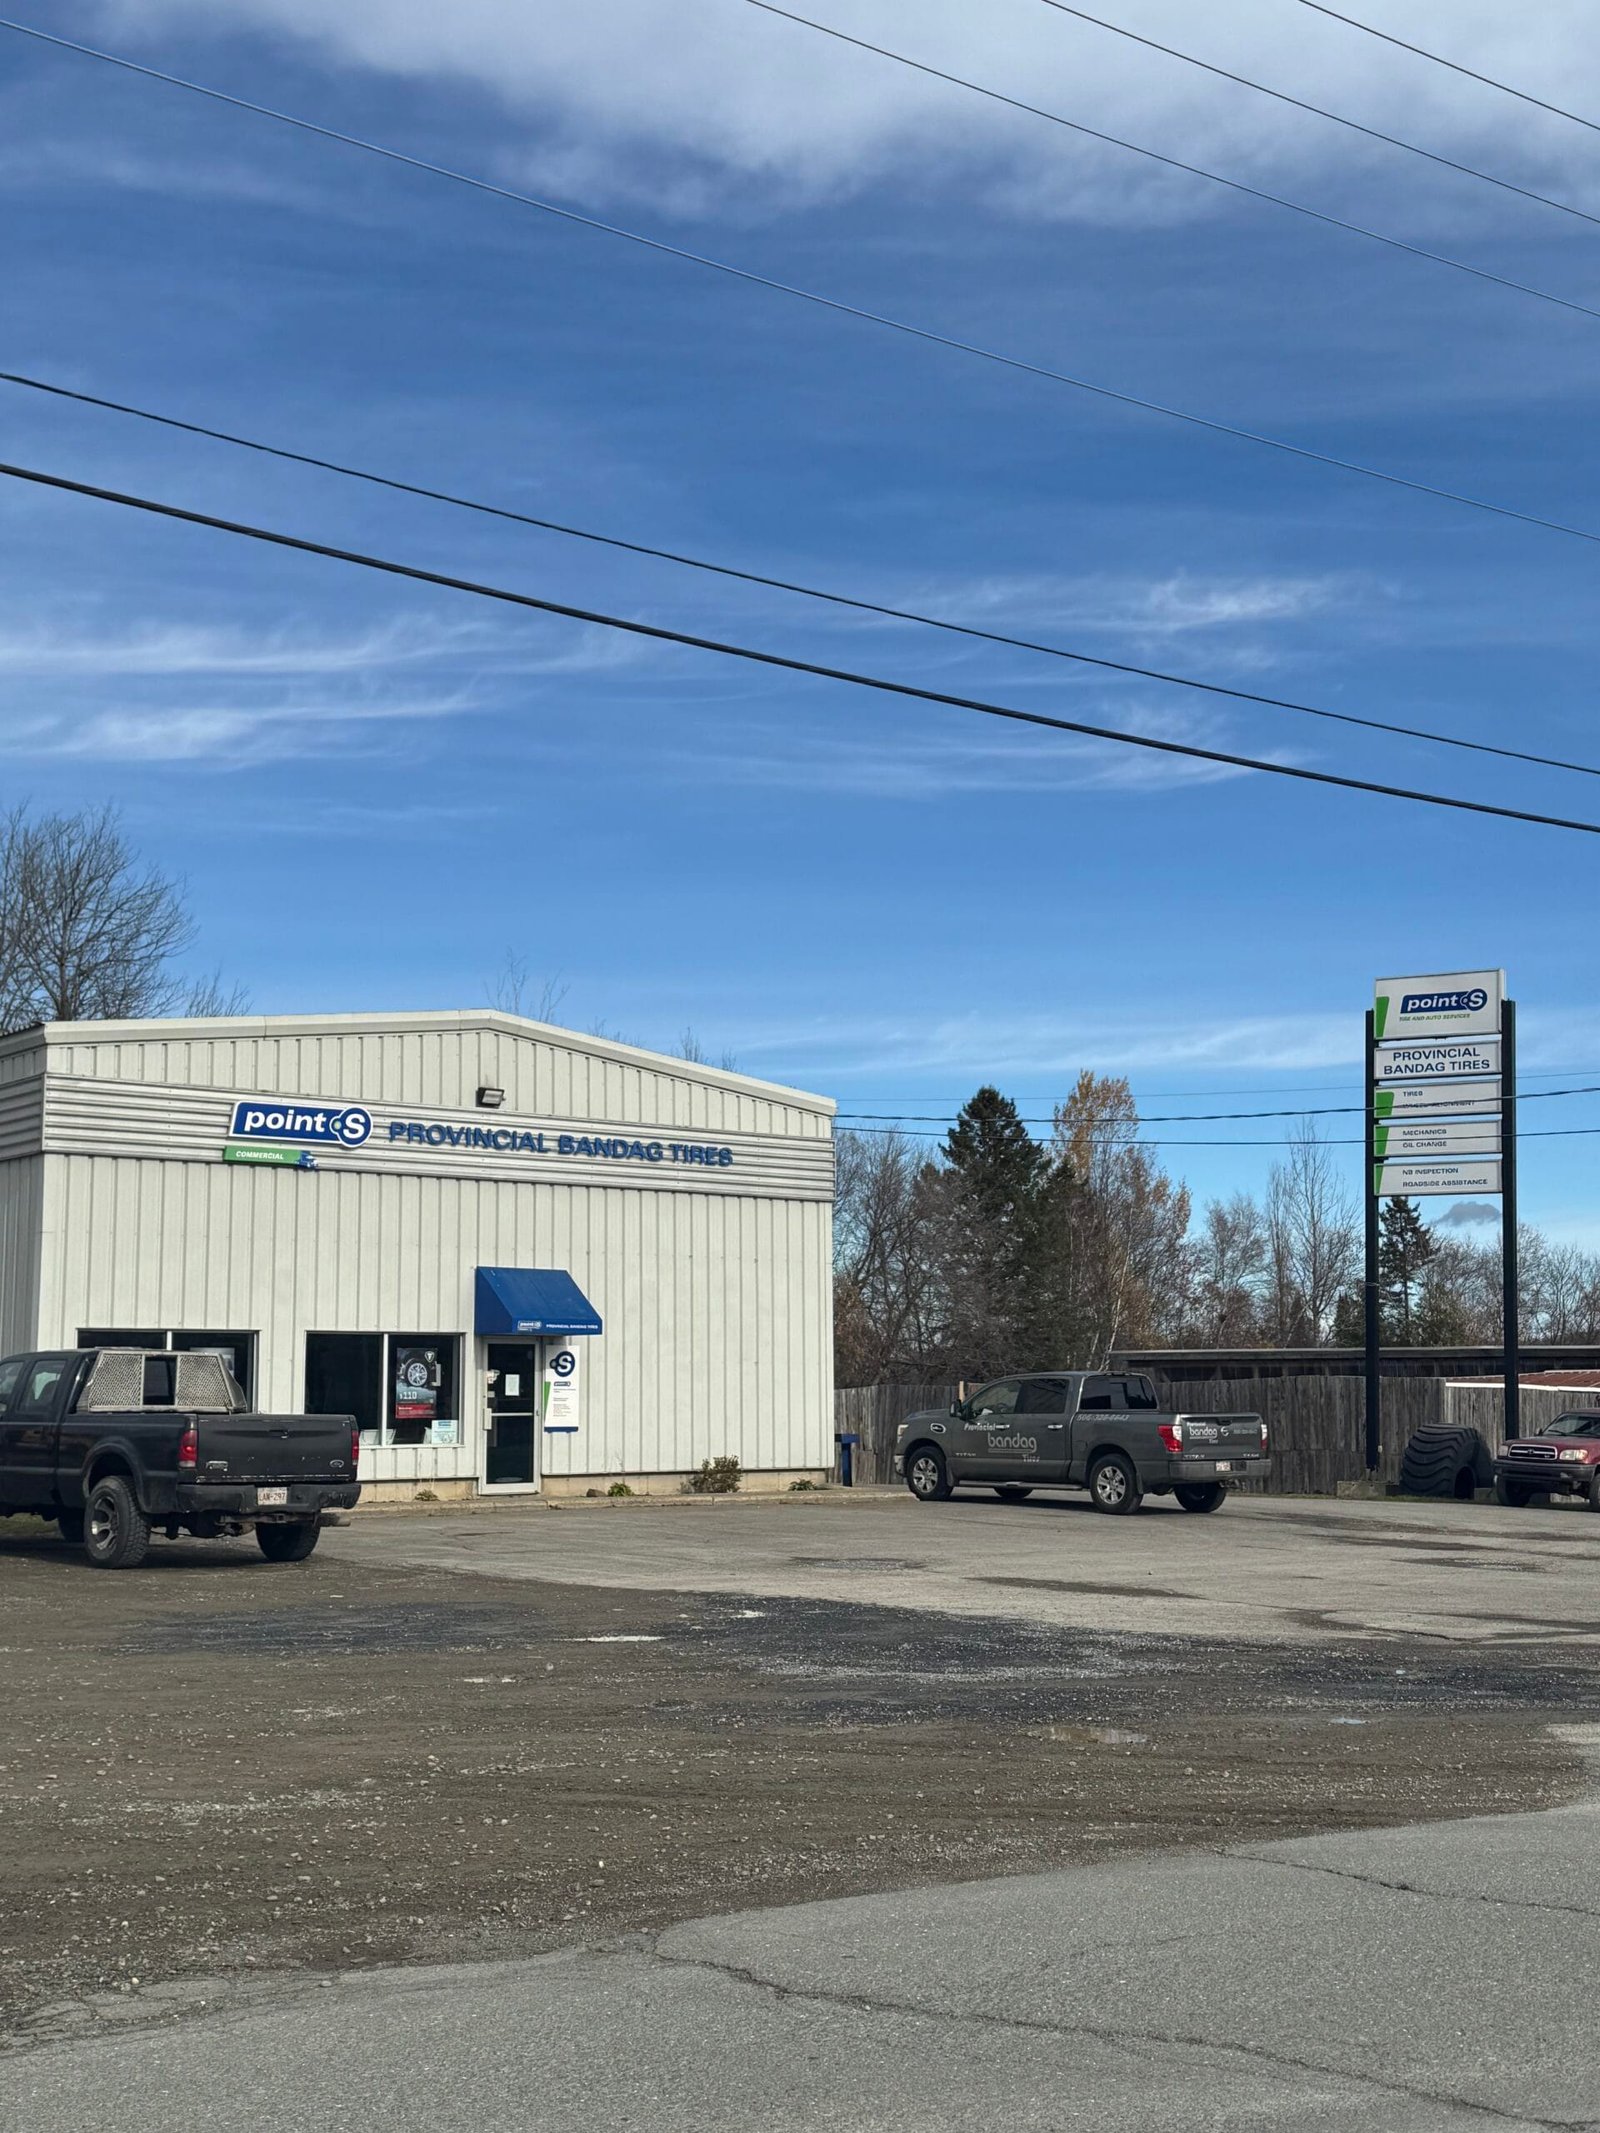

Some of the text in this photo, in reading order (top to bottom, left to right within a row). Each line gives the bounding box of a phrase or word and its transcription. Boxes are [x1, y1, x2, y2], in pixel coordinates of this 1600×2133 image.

[1407, 991, 1484, 1011] point S
[1393, 1047, 1480, 1061] PROVINCIAL
[1384, 1059, 1490, 1075] BANDAG TIRES
[244, 1109, 366, 1139] point S
[1402, 1128, 1447, 1136] MECHANICS
[389, 1121, 733, 1167] PROVINCIAL BANDAG TIRES
[235, 1150, 284, 1160] COMMERCIAL
[1415, 1167, 1459, 1175] INSPECTION
[1441, 1178, 1488, 1187] ASSISTANCE
[557, 1355, 573, 1373] S
[963, 1422, 996, 1431] Provincial
[1189, 1426, 1218, 1439] bandag
[988, 1433, 1038, 1453] bandag
